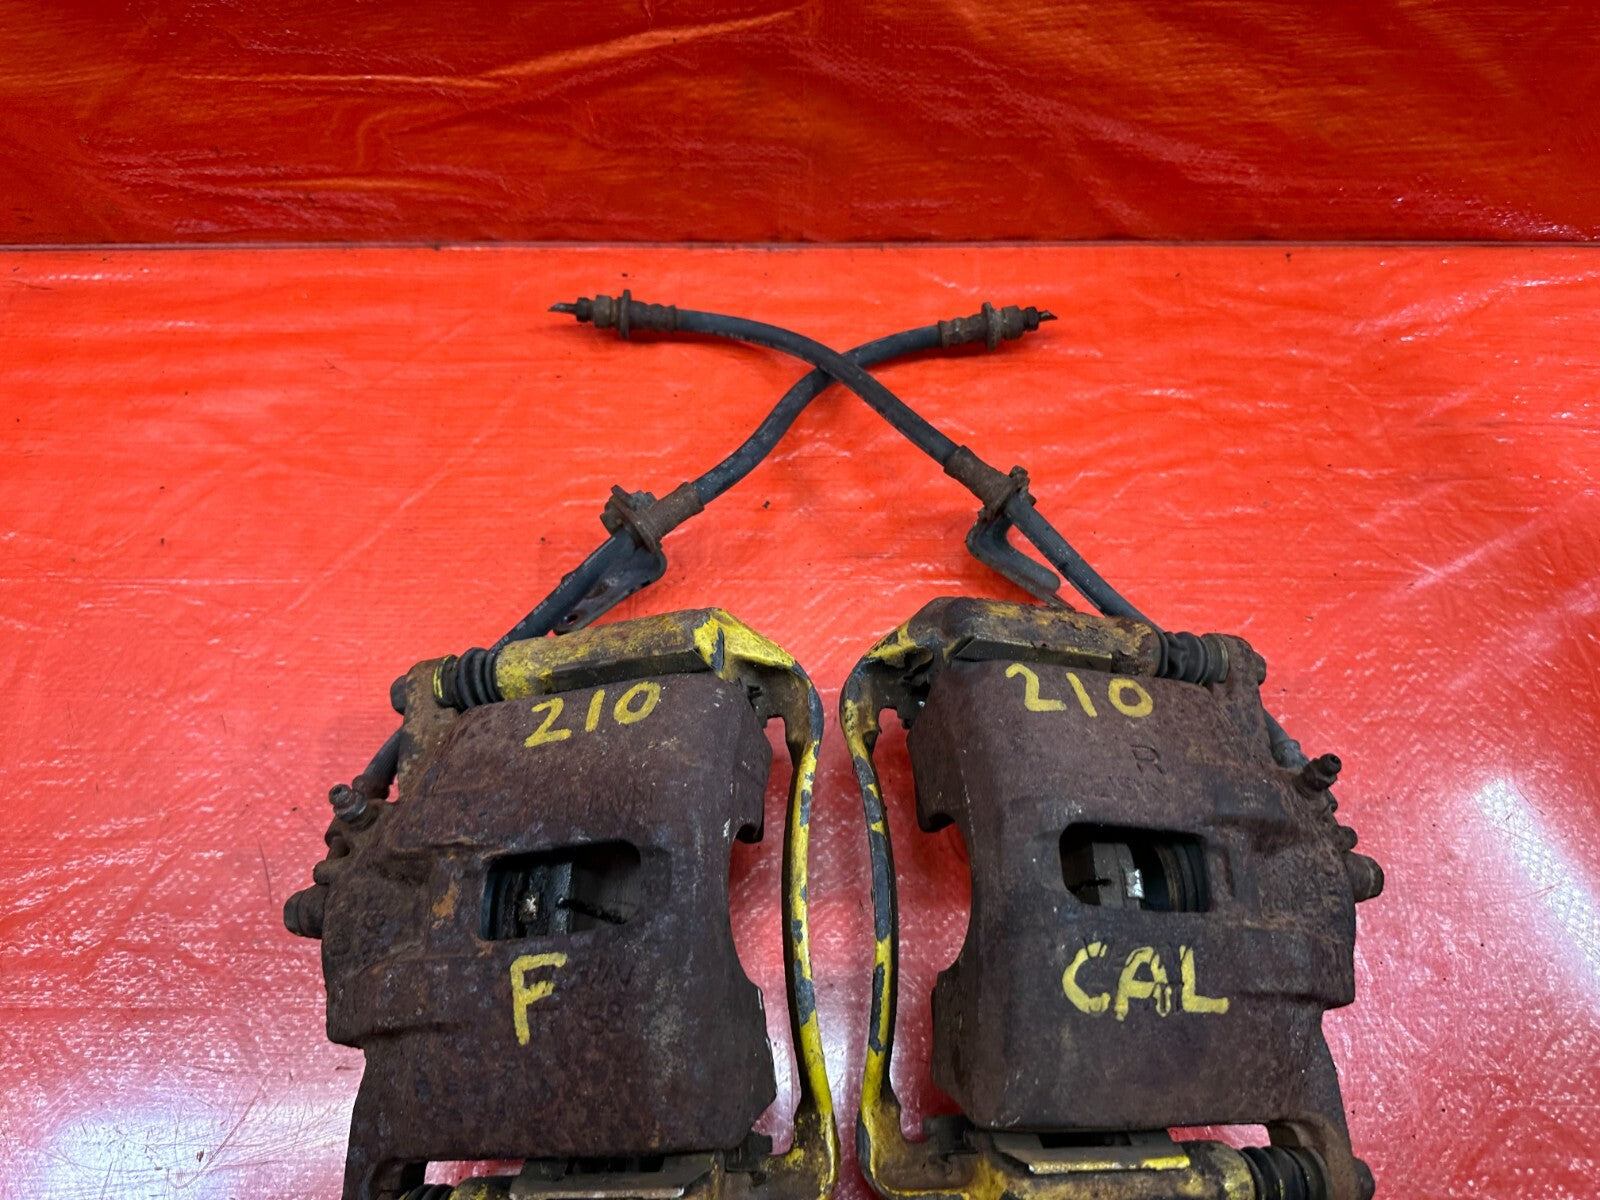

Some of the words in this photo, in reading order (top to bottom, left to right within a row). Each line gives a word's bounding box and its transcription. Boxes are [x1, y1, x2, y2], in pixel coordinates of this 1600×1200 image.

[524, 681, 662, 748] 210
[1004, 663, 1153, 718] 210
[1130, 744, 1166, 776] R
[509, 953, 568, 1046] F
[1061, 940, 1230, 1022] CAL
